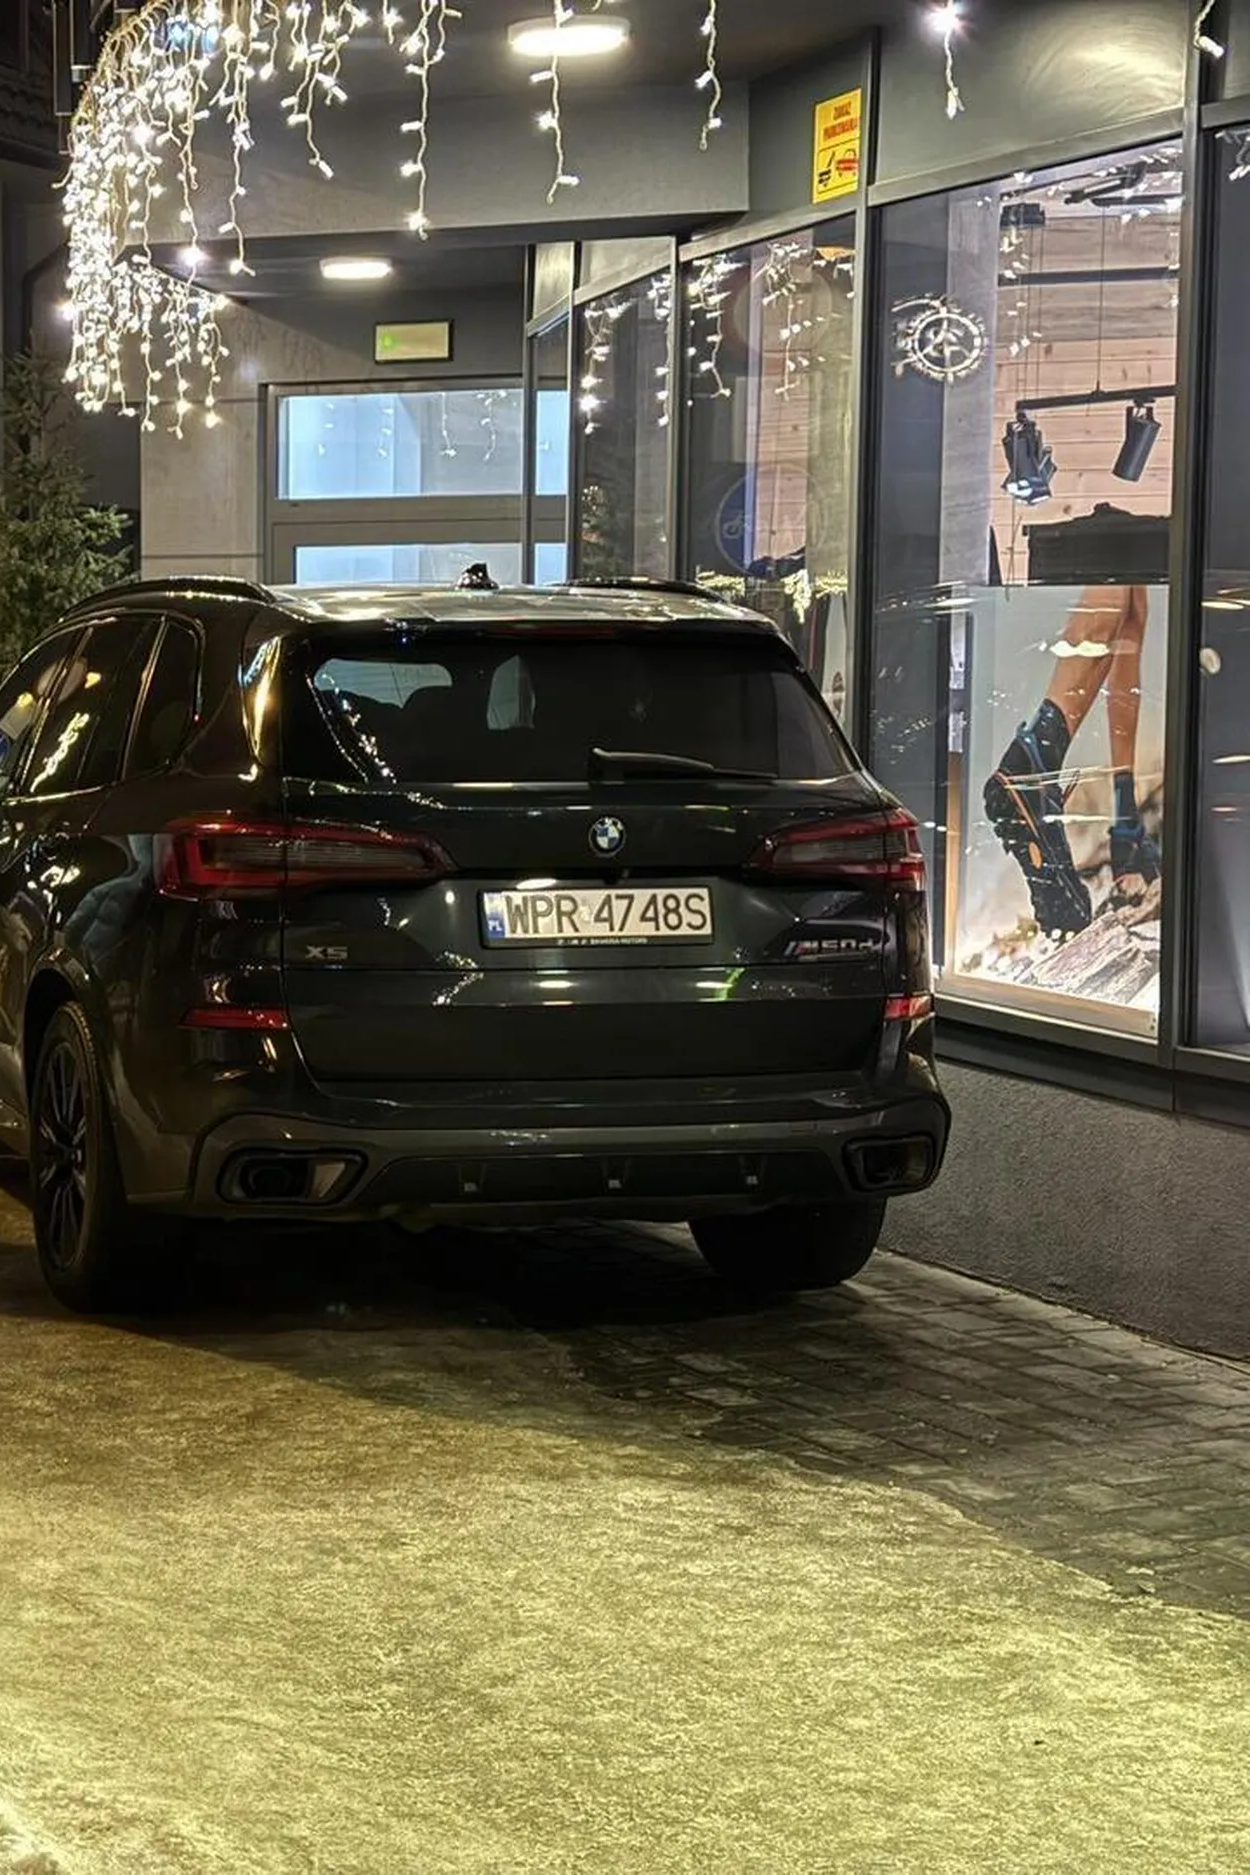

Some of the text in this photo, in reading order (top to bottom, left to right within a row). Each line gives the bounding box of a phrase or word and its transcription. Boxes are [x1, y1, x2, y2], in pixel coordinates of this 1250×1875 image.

[506, 892, 707, 934] WPR 4748S
[488, 919, 503, 931] PL
[305, 945, 348, 959] X5
